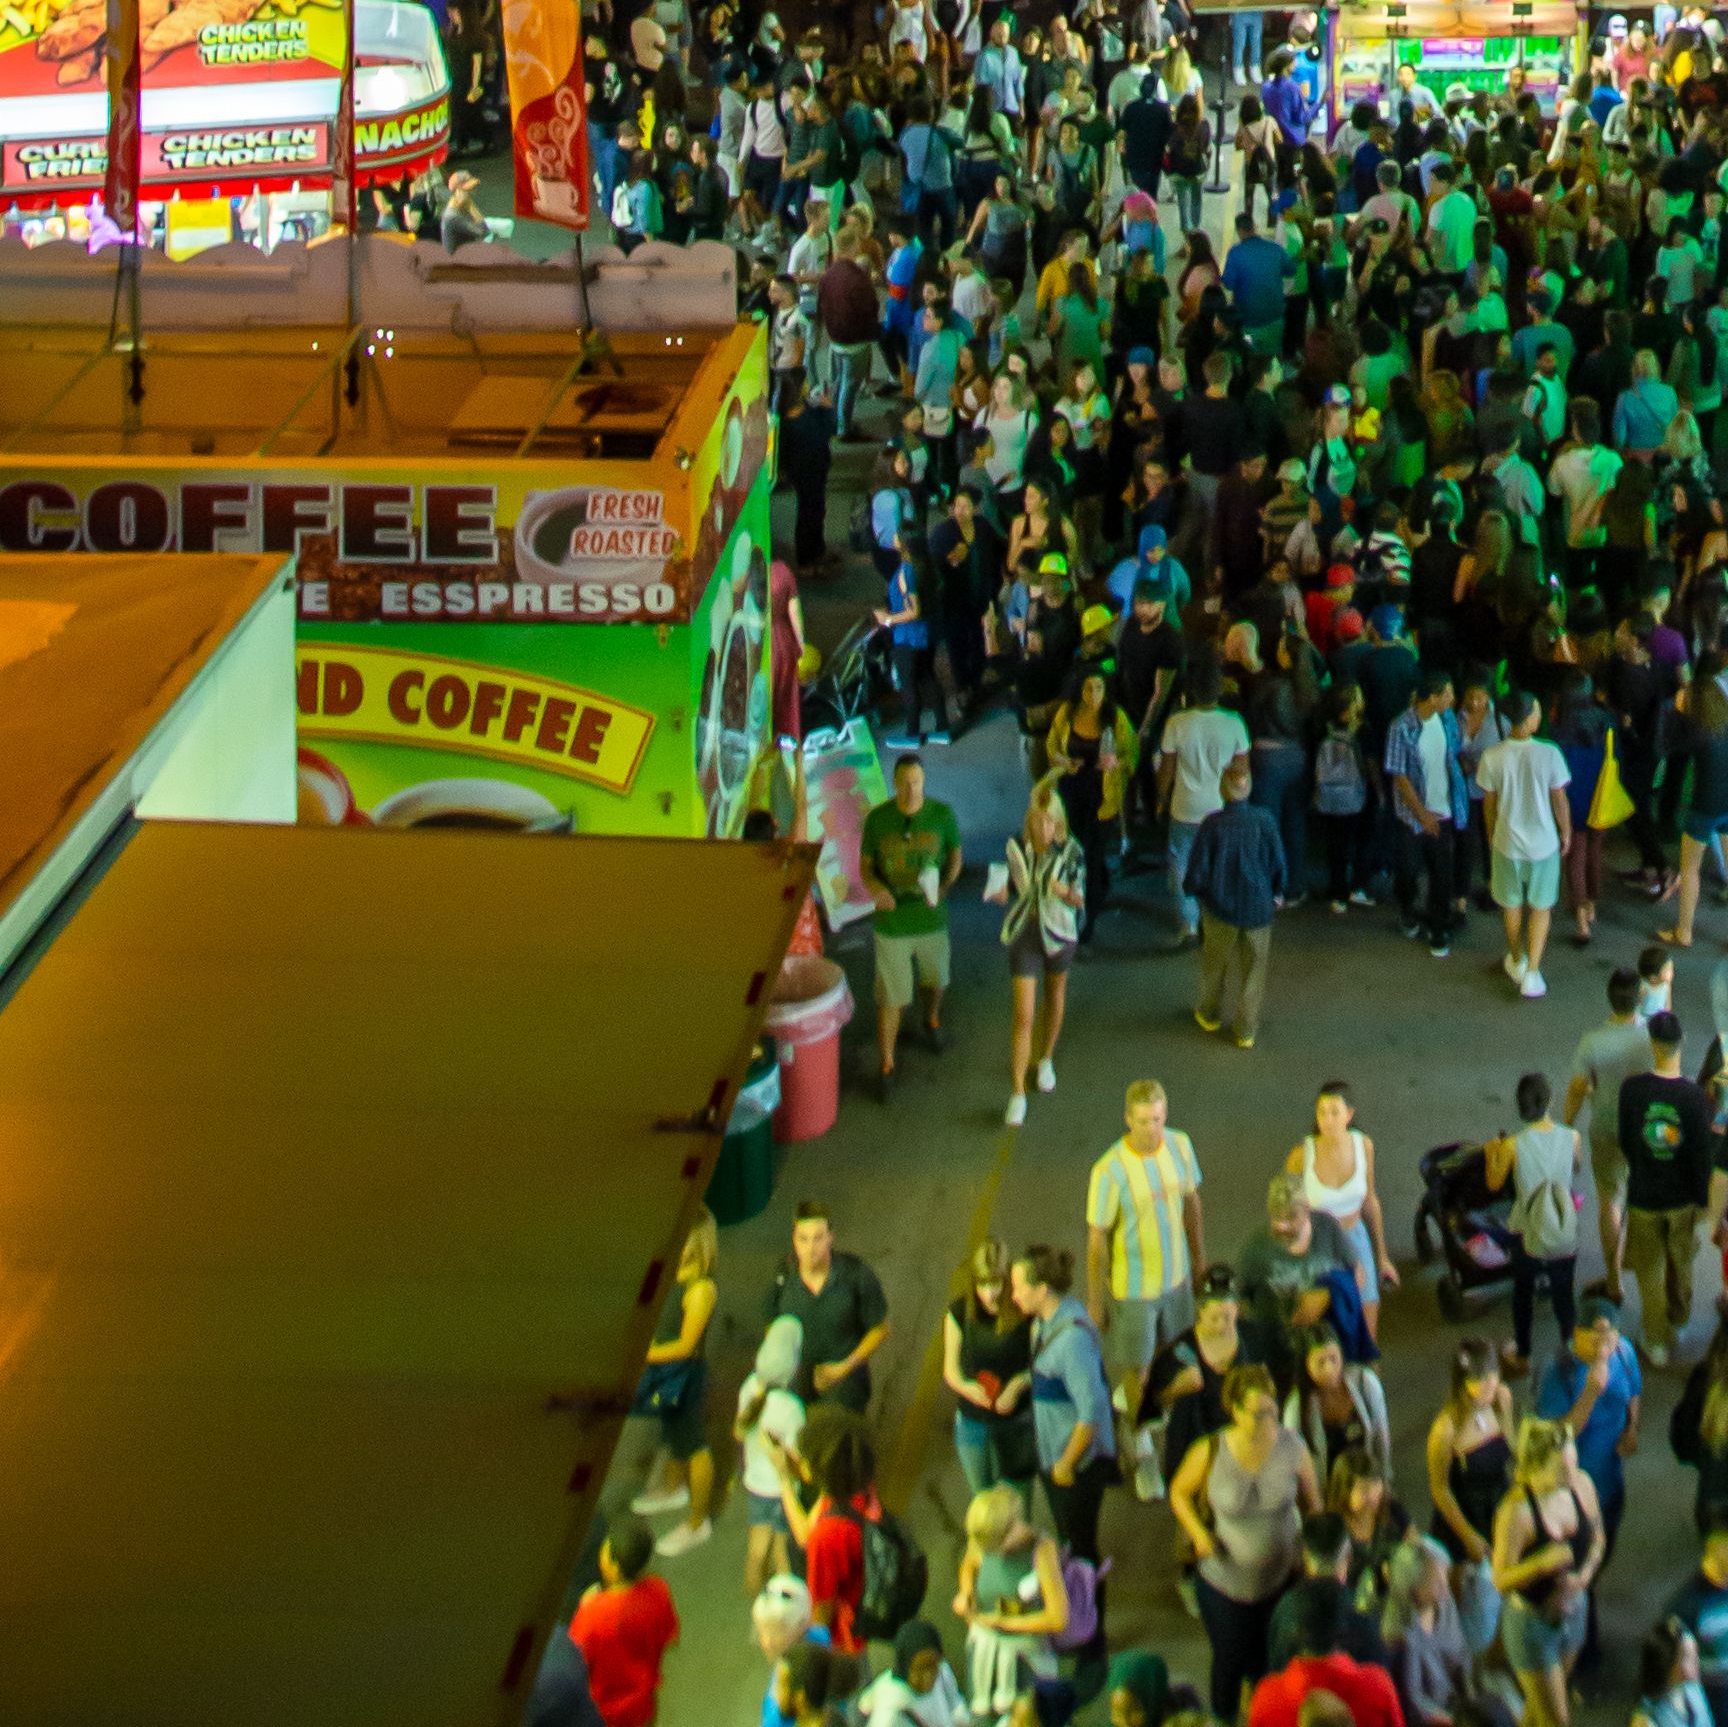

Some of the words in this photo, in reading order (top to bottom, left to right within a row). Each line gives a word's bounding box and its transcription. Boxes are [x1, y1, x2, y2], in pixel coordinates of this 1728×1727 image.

[200, 22, 308, 47] CHICKEN
[201, 41, 308, 65] TENDERS
[20, 142, 108, 162] CURL
[163, 128, 317, 155] CHICKEN
[164, 145, 317, 170] TENDERS
[588, 493, 661, 521] FRESH
[0, 480, 498, 564] COFFEE
[571, 528, 676, 558] ROASTED
[381, 581, 676, 615] ESSPRESSO
[387, 668, 614, 765] COFFEE
